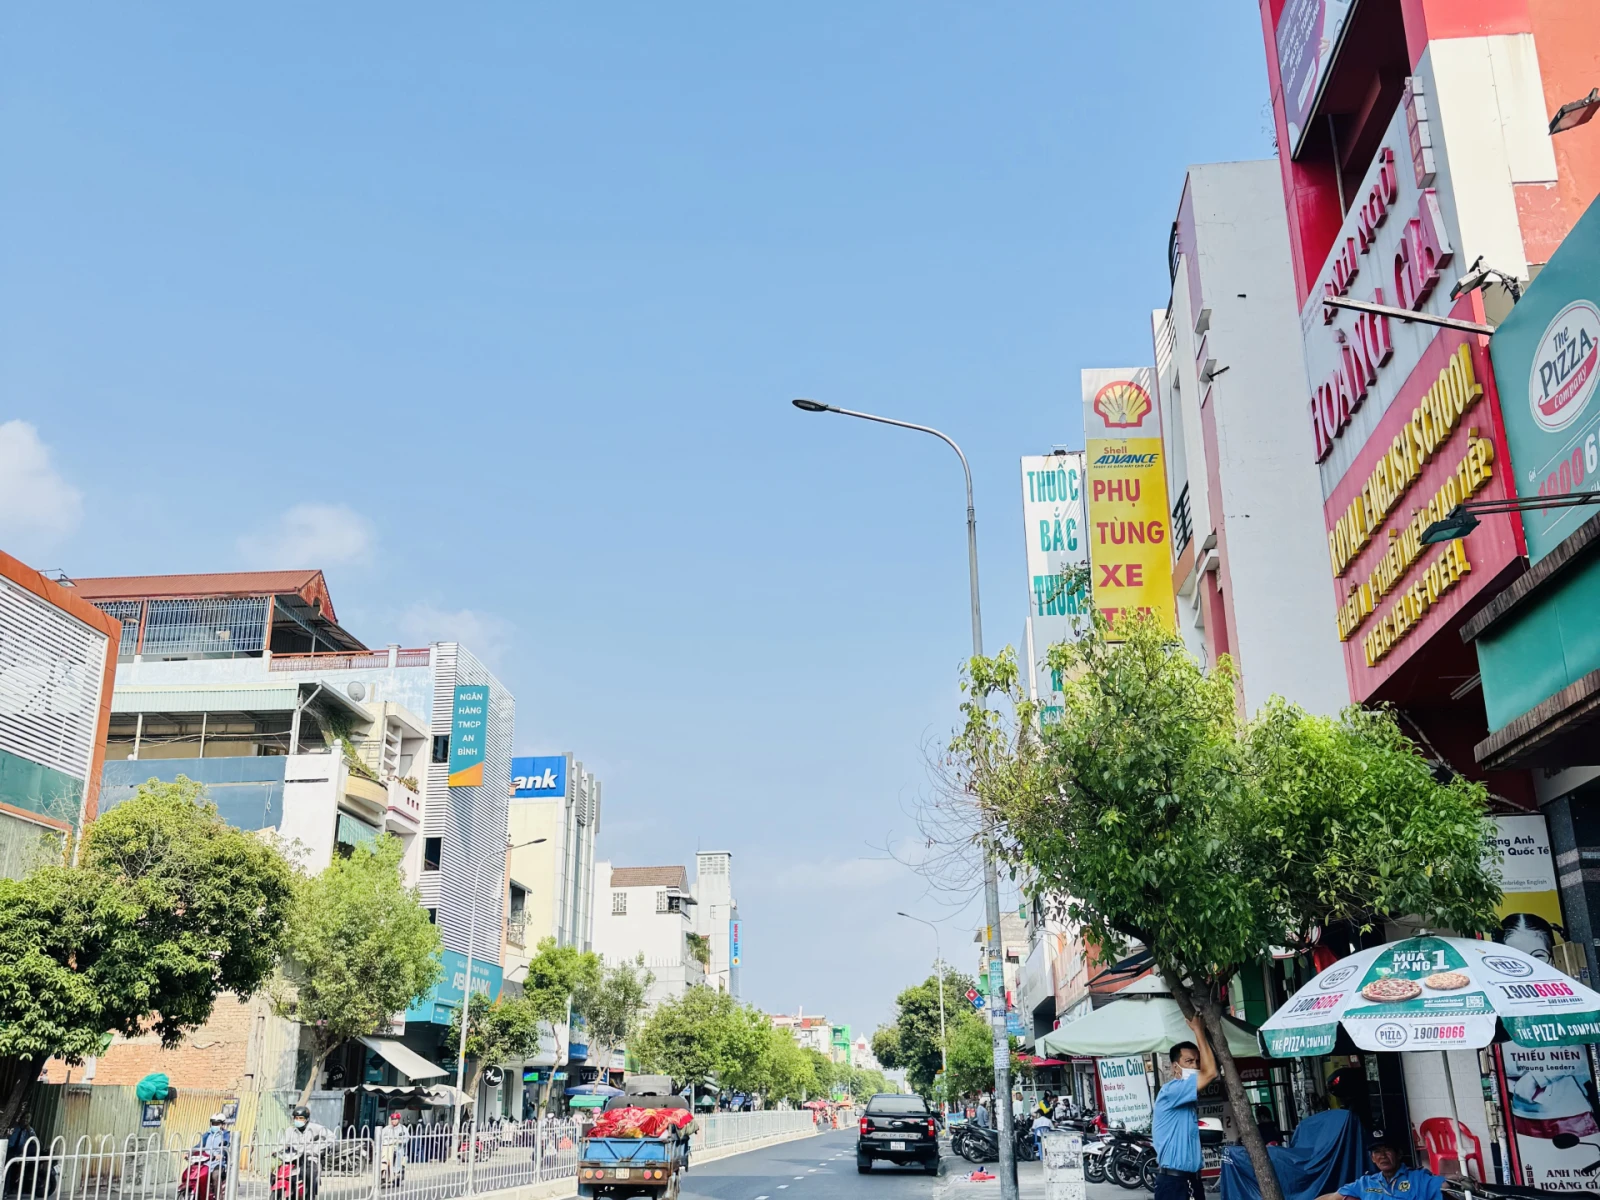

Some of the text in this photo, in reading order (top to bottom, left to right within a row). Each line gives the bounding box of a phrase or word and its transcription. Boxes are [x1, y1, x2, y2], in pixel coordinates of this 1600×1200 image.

[1553, 326, 1569, 352] The
[1539, 328, 1593, 400] PIZZA
[1310, 288, 1393, 464] HOÀNG
[1554, 365, 1587, 409] Company
[1104, 446, 1127, 454] Shell
[1093, 453, 1160, 464] ADVANCE
[1329, 343, 1483, 578] ROYAL ENGLISH SCHOOL
[1456, 427, 1494, 499] TIẾP
[1537, 424, 1600, 517] 19006
[1027, 459, 1079, 503] THUỐC
[1093, 478, 1141, 507] PHỤ
[1040, 507, 1078, 552] BẮC
[1096, 516, 1165, 545] TÙNG
[1098, 564, 1144, 587] XE
[459, 692, 483, 701] NGÂN
[458, 705, 482, 715] HÀNG
[457, 720, 481, 728] TMCP
[462, 734, 475, 742] AN
[457, 746, 478, 756] BÌNH
[1484, 835, 1535, 847] iếng Anh
[1507, 846, 1535, 856] Quốc
[1537, 846, 1550, 855] Tế
[1499, 879, 1526, 887] ambridge
[1393, 952, 1425, 962] MUA
[1432, 950, 1450, 970] 1
[451, 971, 492, 997] ABANK
[1499, 982, 1574, 999] 19006066
[1380, 1030, 1402, 1040] PIZZA
[1413, 1025, 1465, 1040] 19006066
[1517, 1022, 1600, 1042] THE PIZZA COMPAN
[1272, 1034, 1332, 1053] THE PIZZA COMPANY
[1510, 1049, 1581, 1061] THIẾU NIÊN
[1100, 1058, 1144, 1079] Châm Cứu
[1207, 1084, 1220, 1095] GO
[1225, 1116, 1232, 1129] 2
[1546, 1169, 1571, 1178] ANH
[1540, 1179, 1583, 1191] HOÀNG
[1585, 1181, 1600, 1190] GI
